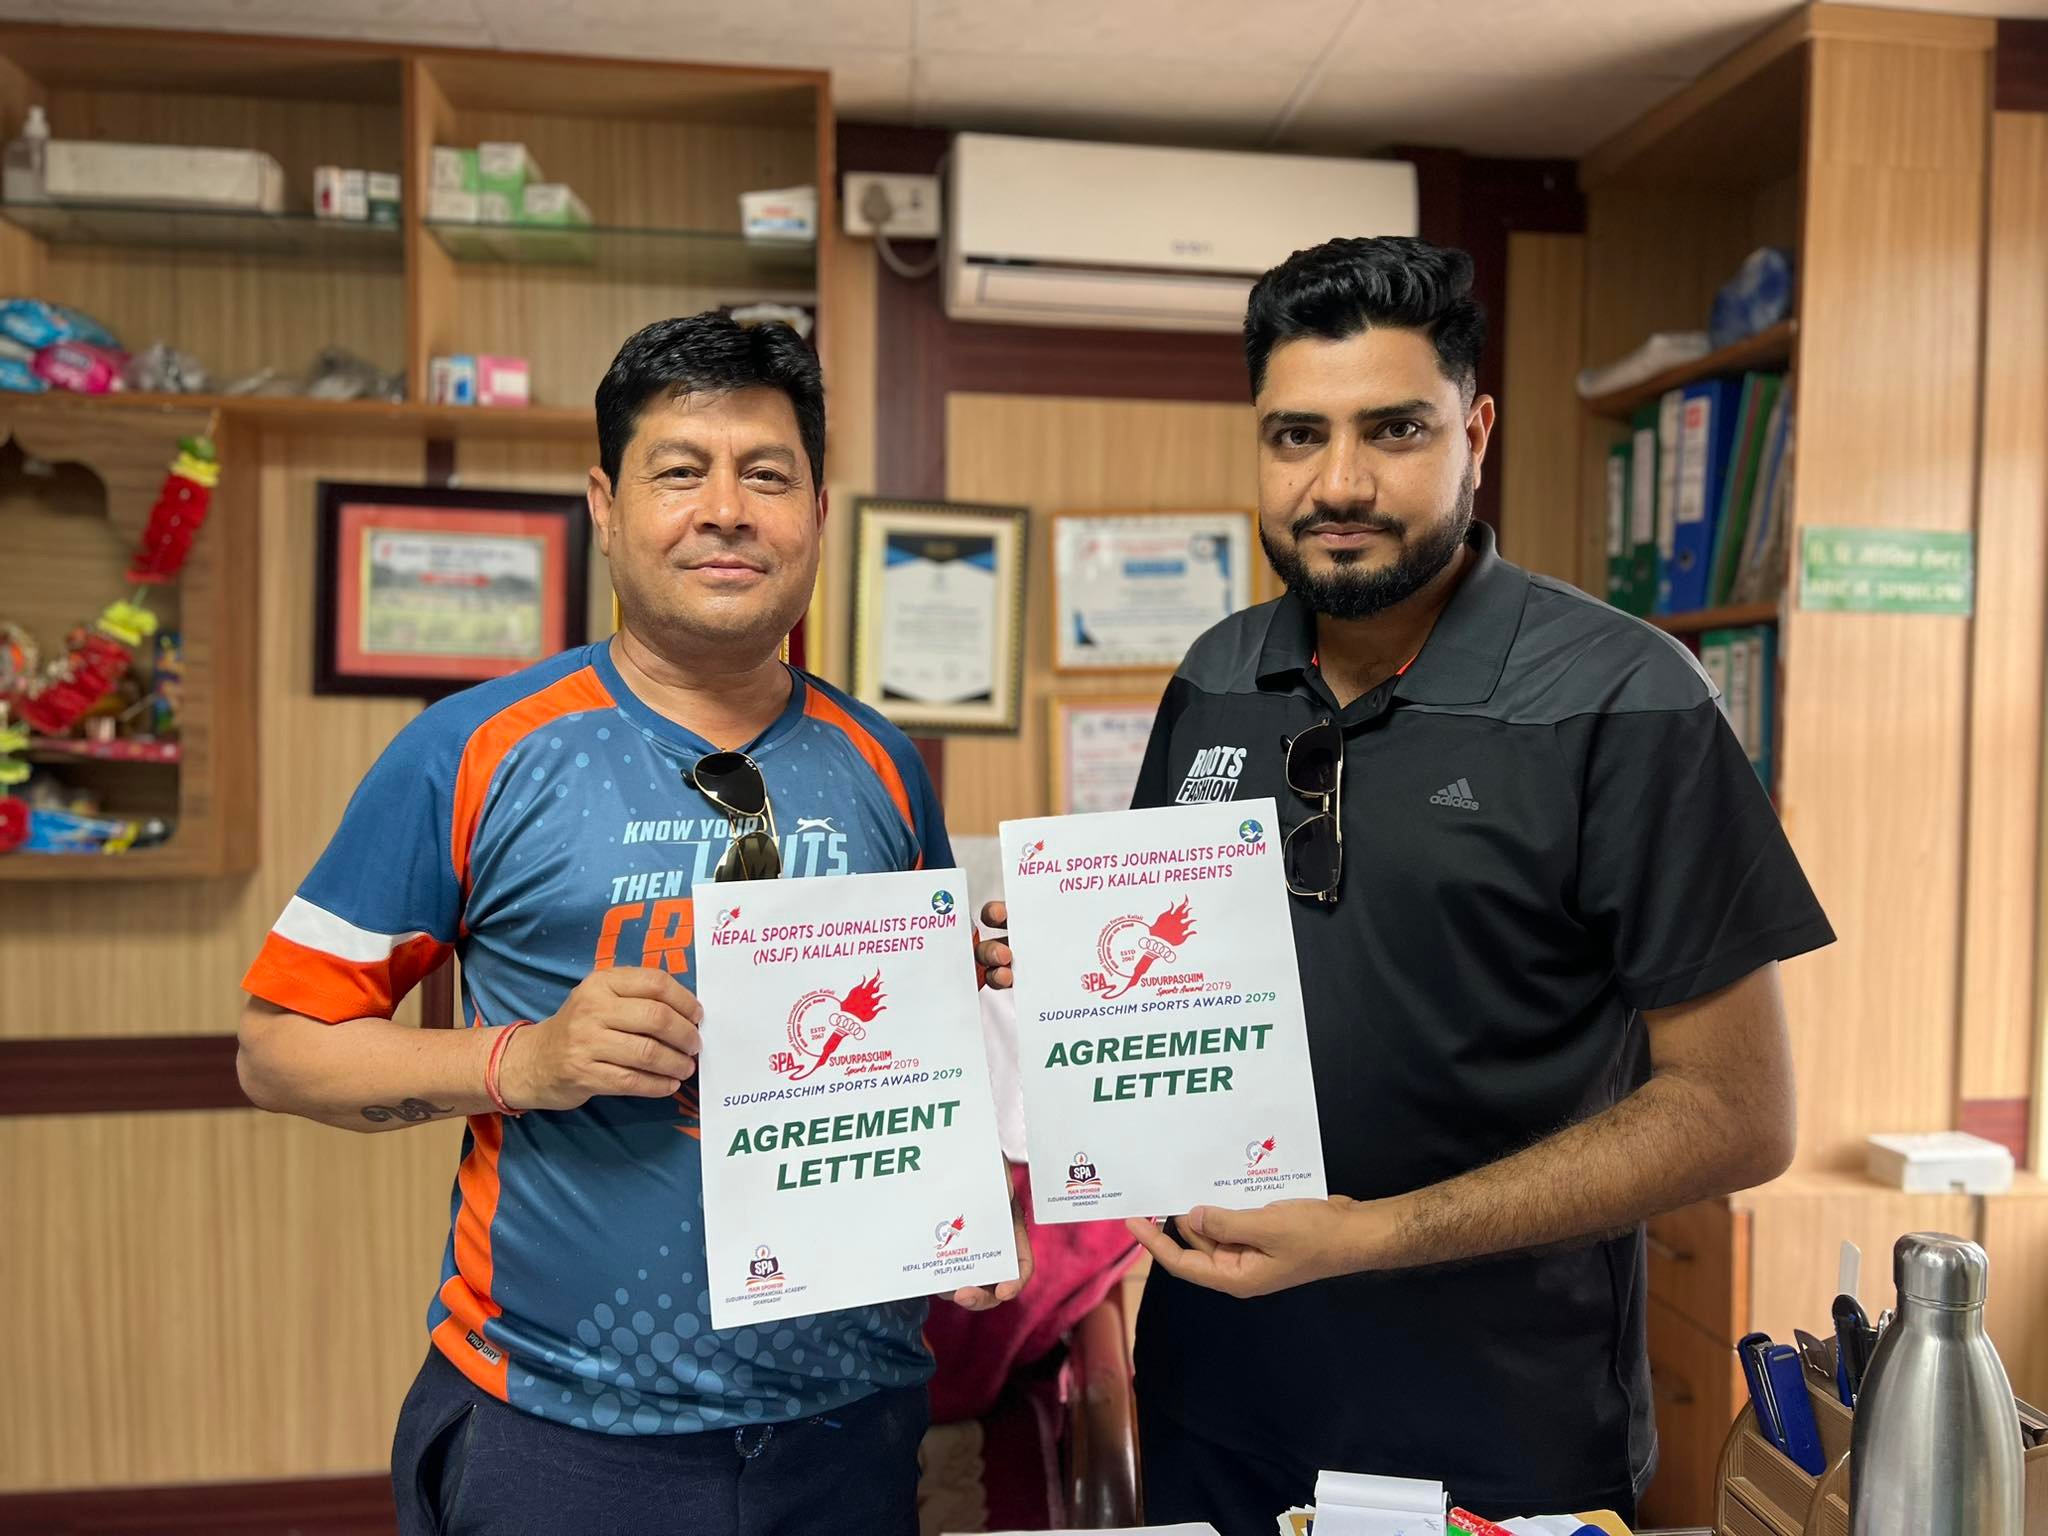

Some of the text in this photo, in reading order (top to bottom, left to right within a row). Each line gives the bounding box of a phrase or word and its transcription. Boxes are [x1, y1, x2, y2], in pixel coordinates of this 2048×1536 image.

[1187, 745, 1247, 778] ROOTS
[1177, 778, 1236, 803] FASHION
[1430, 795, 1480, 811] adidas
[623, 816, 758, 845] KNOW YOUR
[1018, 842, 1266, 876] NEPAL SPORTS JOURNALISTS FORUM
[611, 870, 684, 905] THEN
[1059, 864, 1233, 894] (NSJF) KAILALI PRESENTS
[712, 914, 956, 946] NEPAL SPORTS JOURNALISTS FORUM
[753, 936, 924, 965] (NSJF) KAILALI PRESENTS
[1140, 972, 1204, 988] SUDURPASCHIM
[1156, 981, 1232, 997] Sports Award 2079
[1039, 991, 1276, 1022] SUDURPASCHIM SPORTS AWARD 2079
[829, 1050, 892, 1067] SUDURPASCHIM
[1044, 1024, 1274, 1069] AGREEMENT
[844, 1058, 919, 1077] Sports Award 2079
[723, 1068, 963, 1107] SUDURPASCHIM SPORTS AWARD 2079
[1093, 1065, 1234, 1103] LETTER
[726, 1100, 961, 1157] AGREEMENT
[776, 1145, 922, 1191] LETTER
[1073, 1166, 1092, 1179] SPA
[1233, 1178, 1253, 1186] SPORTS
[1254, 1174, 1291, 1184] JOURNALISTS
[1291, 1172, 1312, 1181] FORUM
[1246, 1167, 1279, 1177] ORGANIZER
[1263, 1183, 1285, 1191] KAILALI
[902, 1250, 1002, 1272] NEPAL SPORTS JOURNALISTS FORUM
[936, 1247, 969, 1259] ORGANIZER
[754, 1260, 775, 1276] SPA
[953, 1263, 975, 1273] KAILALI
[467, 1332, 500, 1361] PRO DRY
